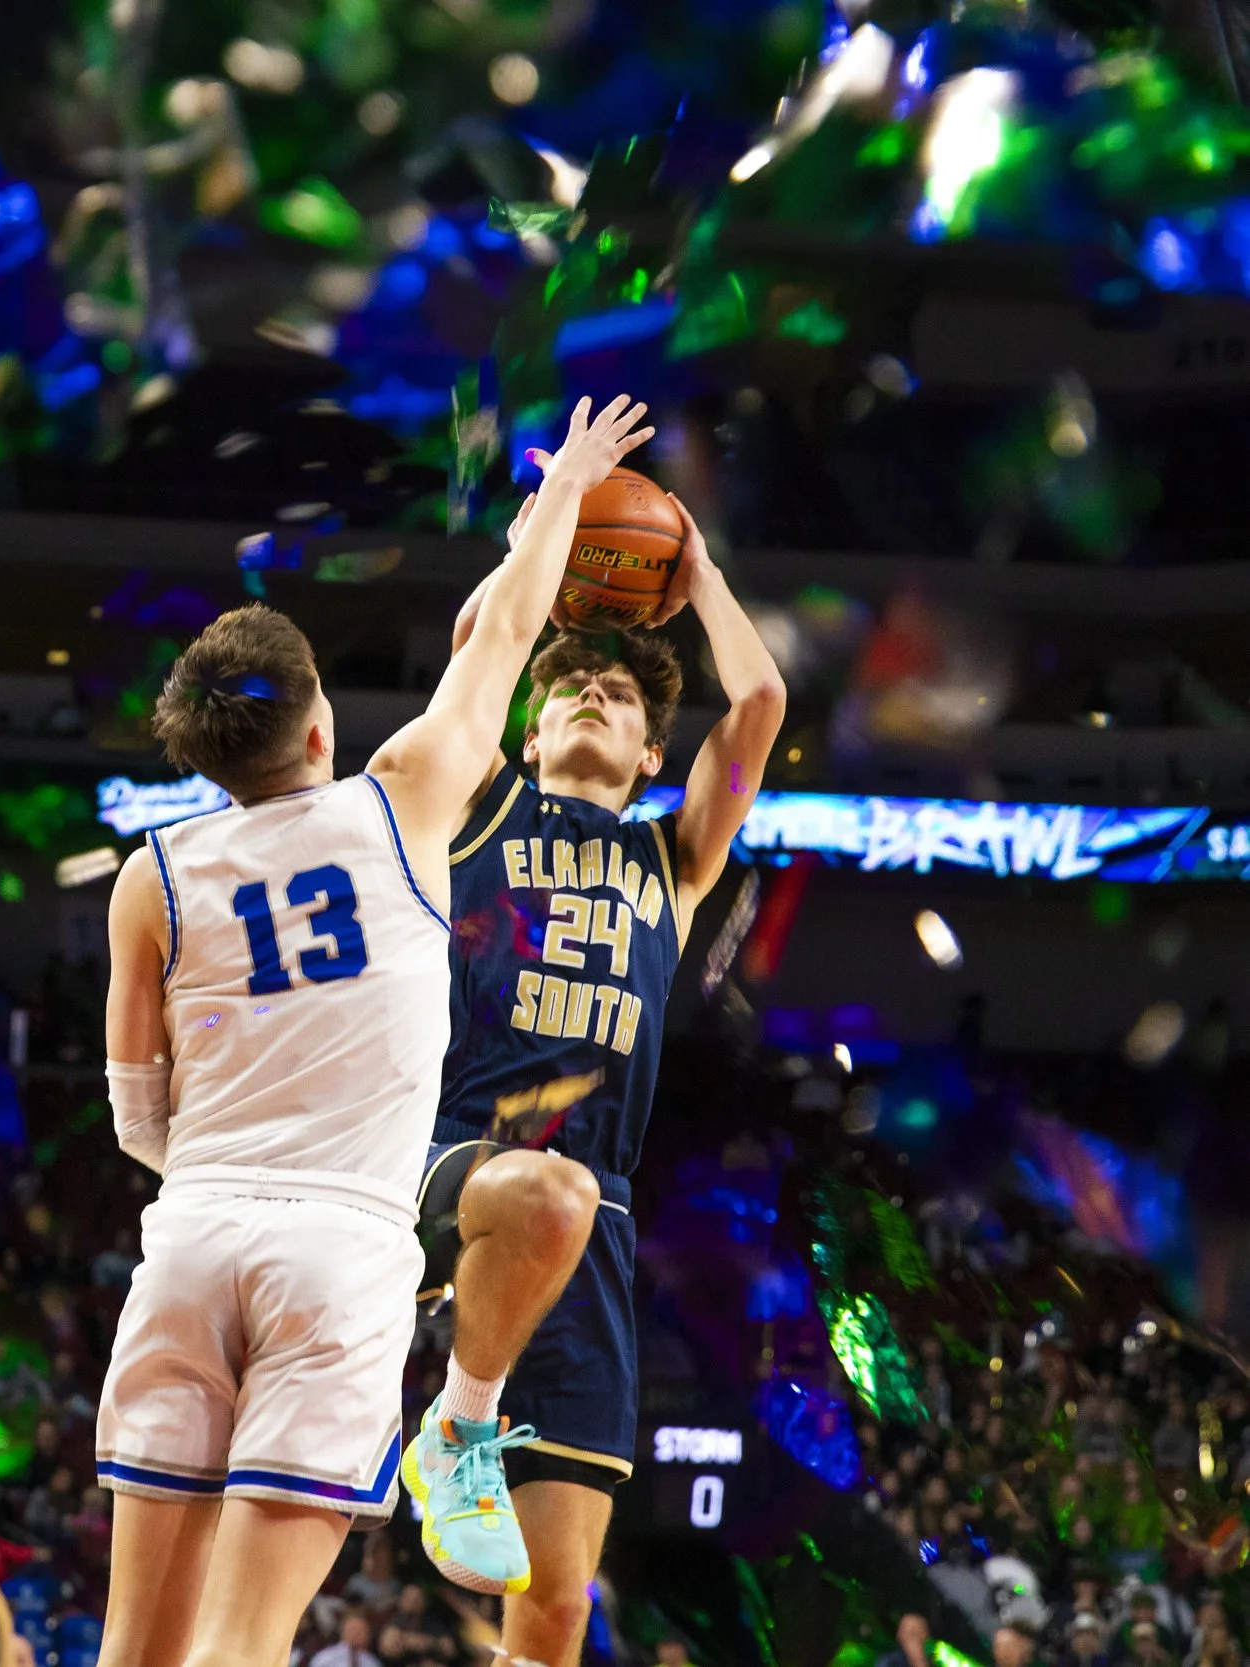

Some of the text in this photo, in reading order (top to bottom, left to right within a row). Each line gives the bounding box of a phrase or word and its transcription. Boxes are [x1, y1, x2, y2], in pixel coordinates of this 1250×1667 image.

[230, 861, 370, 996] 13
[542, 893, 632, 978] 24
[510, 970, 642, 1057] SOUTH
[654, 1426, 742, 1464] STORM
[690, 1475, 724, 1528] 0
